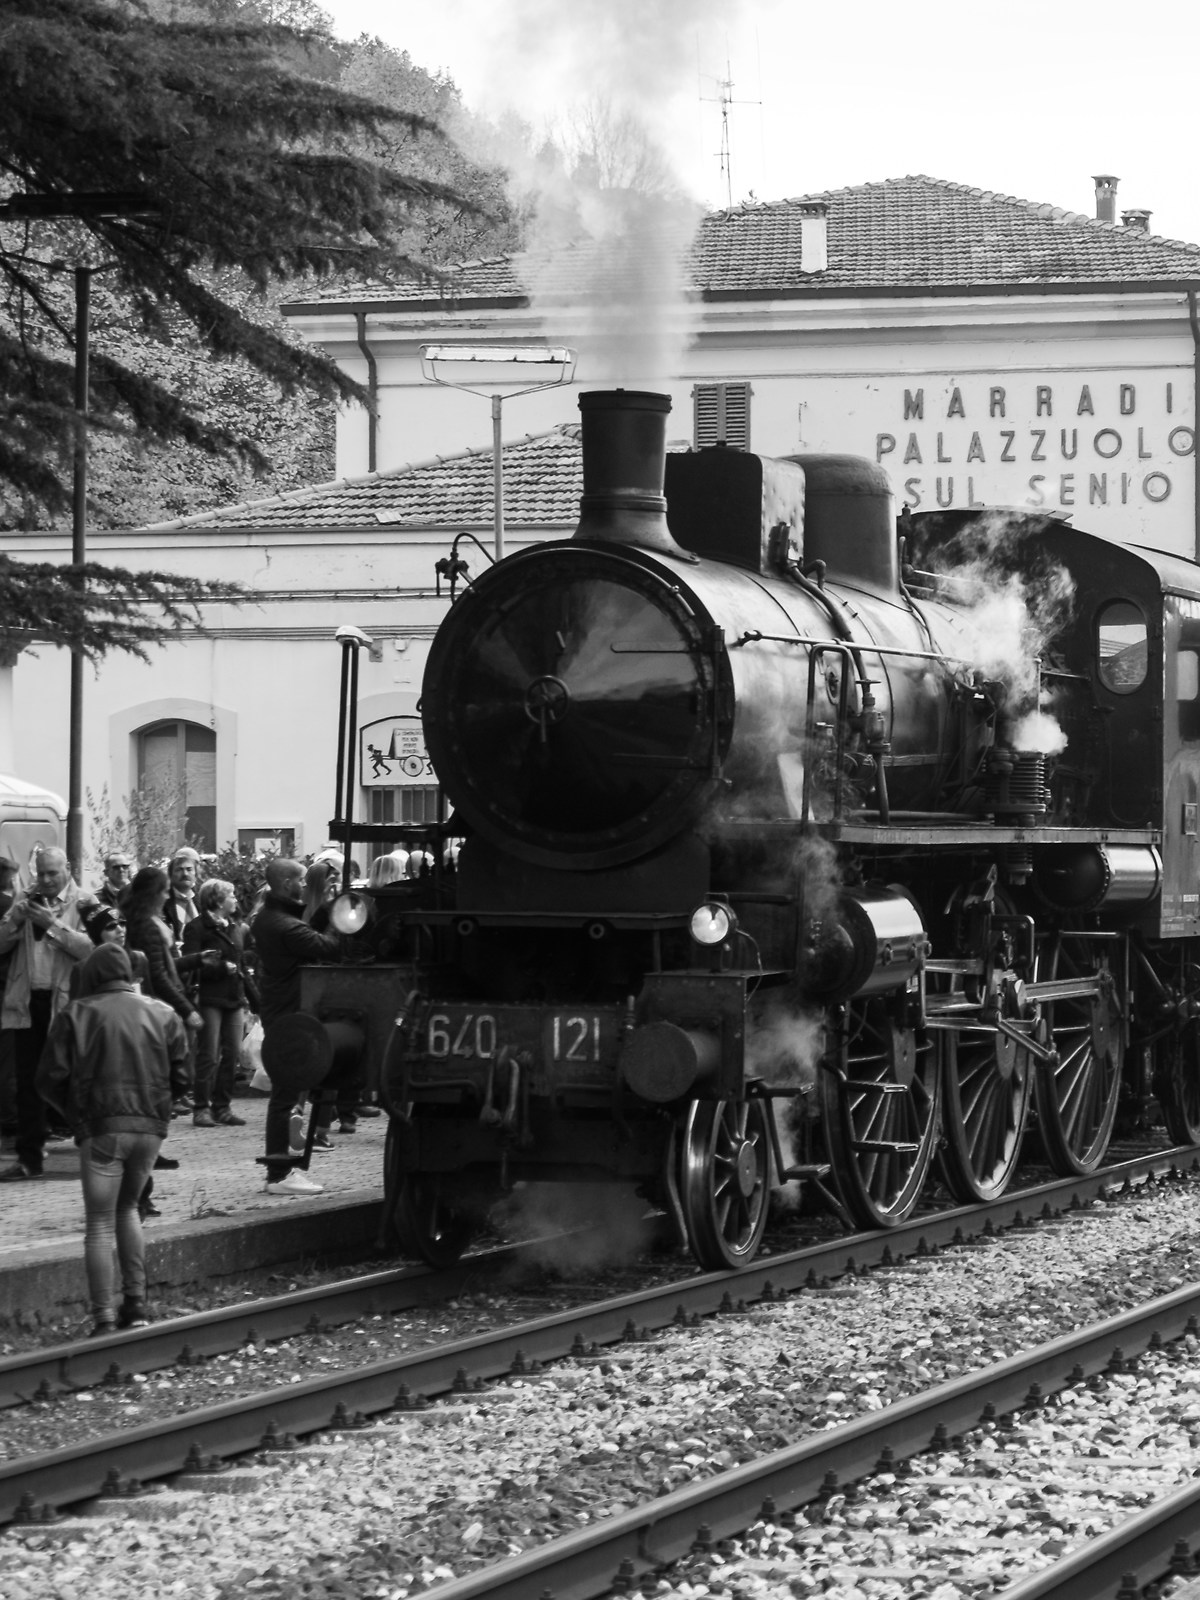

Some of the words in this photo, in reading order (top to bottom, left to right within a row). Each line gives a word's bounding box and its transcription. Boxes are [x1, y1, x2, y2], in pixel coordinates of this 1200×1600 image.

[903, 382, 1173, 420] MARRADI
[876, 425, 1196, 464] PALAZZUOLO
[903, 476, 985, 508] SUL
[1026, 471, 1172, 506] SENIO
[428, 1014, 497, 1059] 640
[553, 1016, 600, 1062] 121
